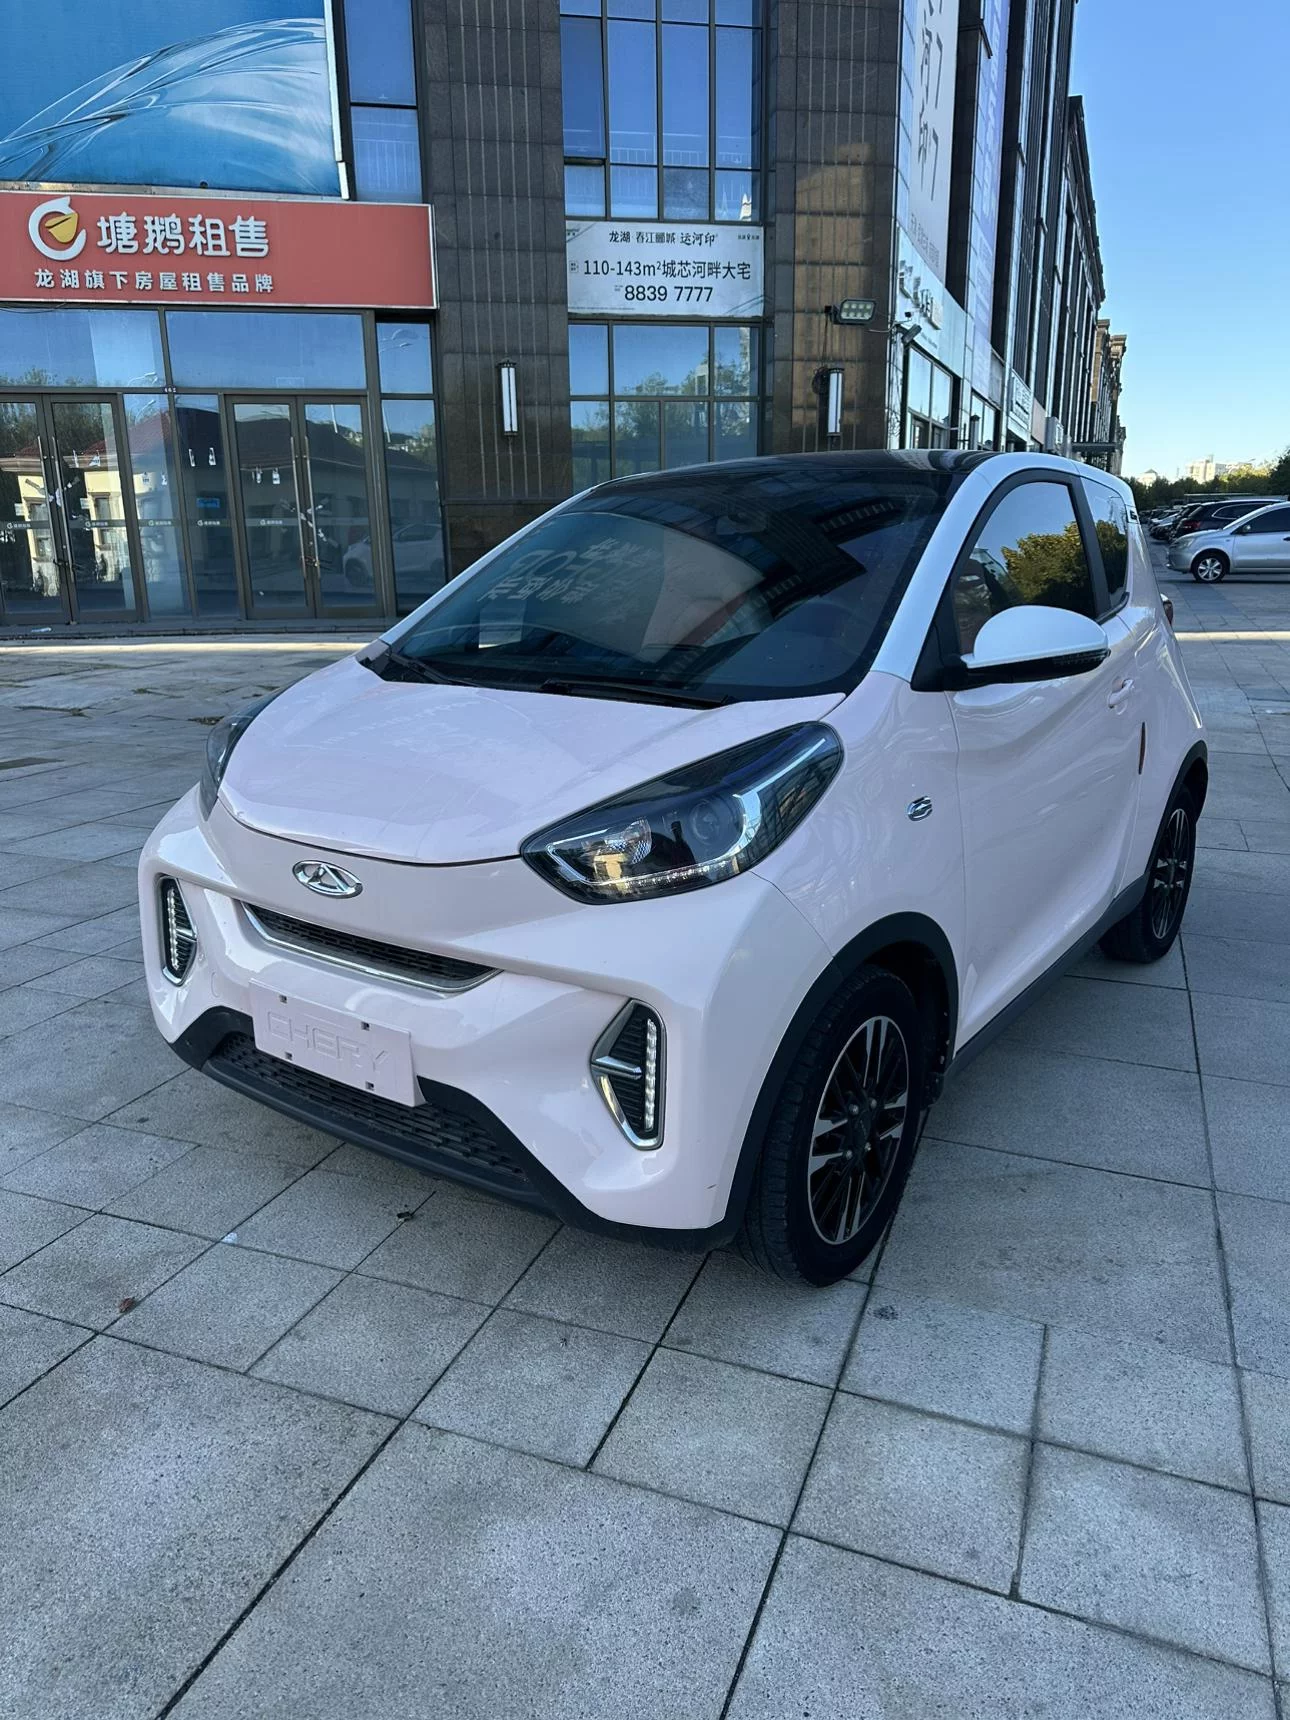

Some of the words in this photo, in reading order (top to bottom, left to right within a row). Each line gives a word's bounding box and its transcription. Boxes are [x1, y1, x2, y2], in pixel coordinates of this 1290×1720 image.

[97, 211, 270, 258] 塘鹅租售
[609, 230, 631, 243] 龙湖
[680, 232, 716, 247] 运河印
[35, 269, 273, 293] 龙湖旗下房屋租售品牌
[624, 285, 668, 302] 8839
[674, 286, 713, 302] 7777
